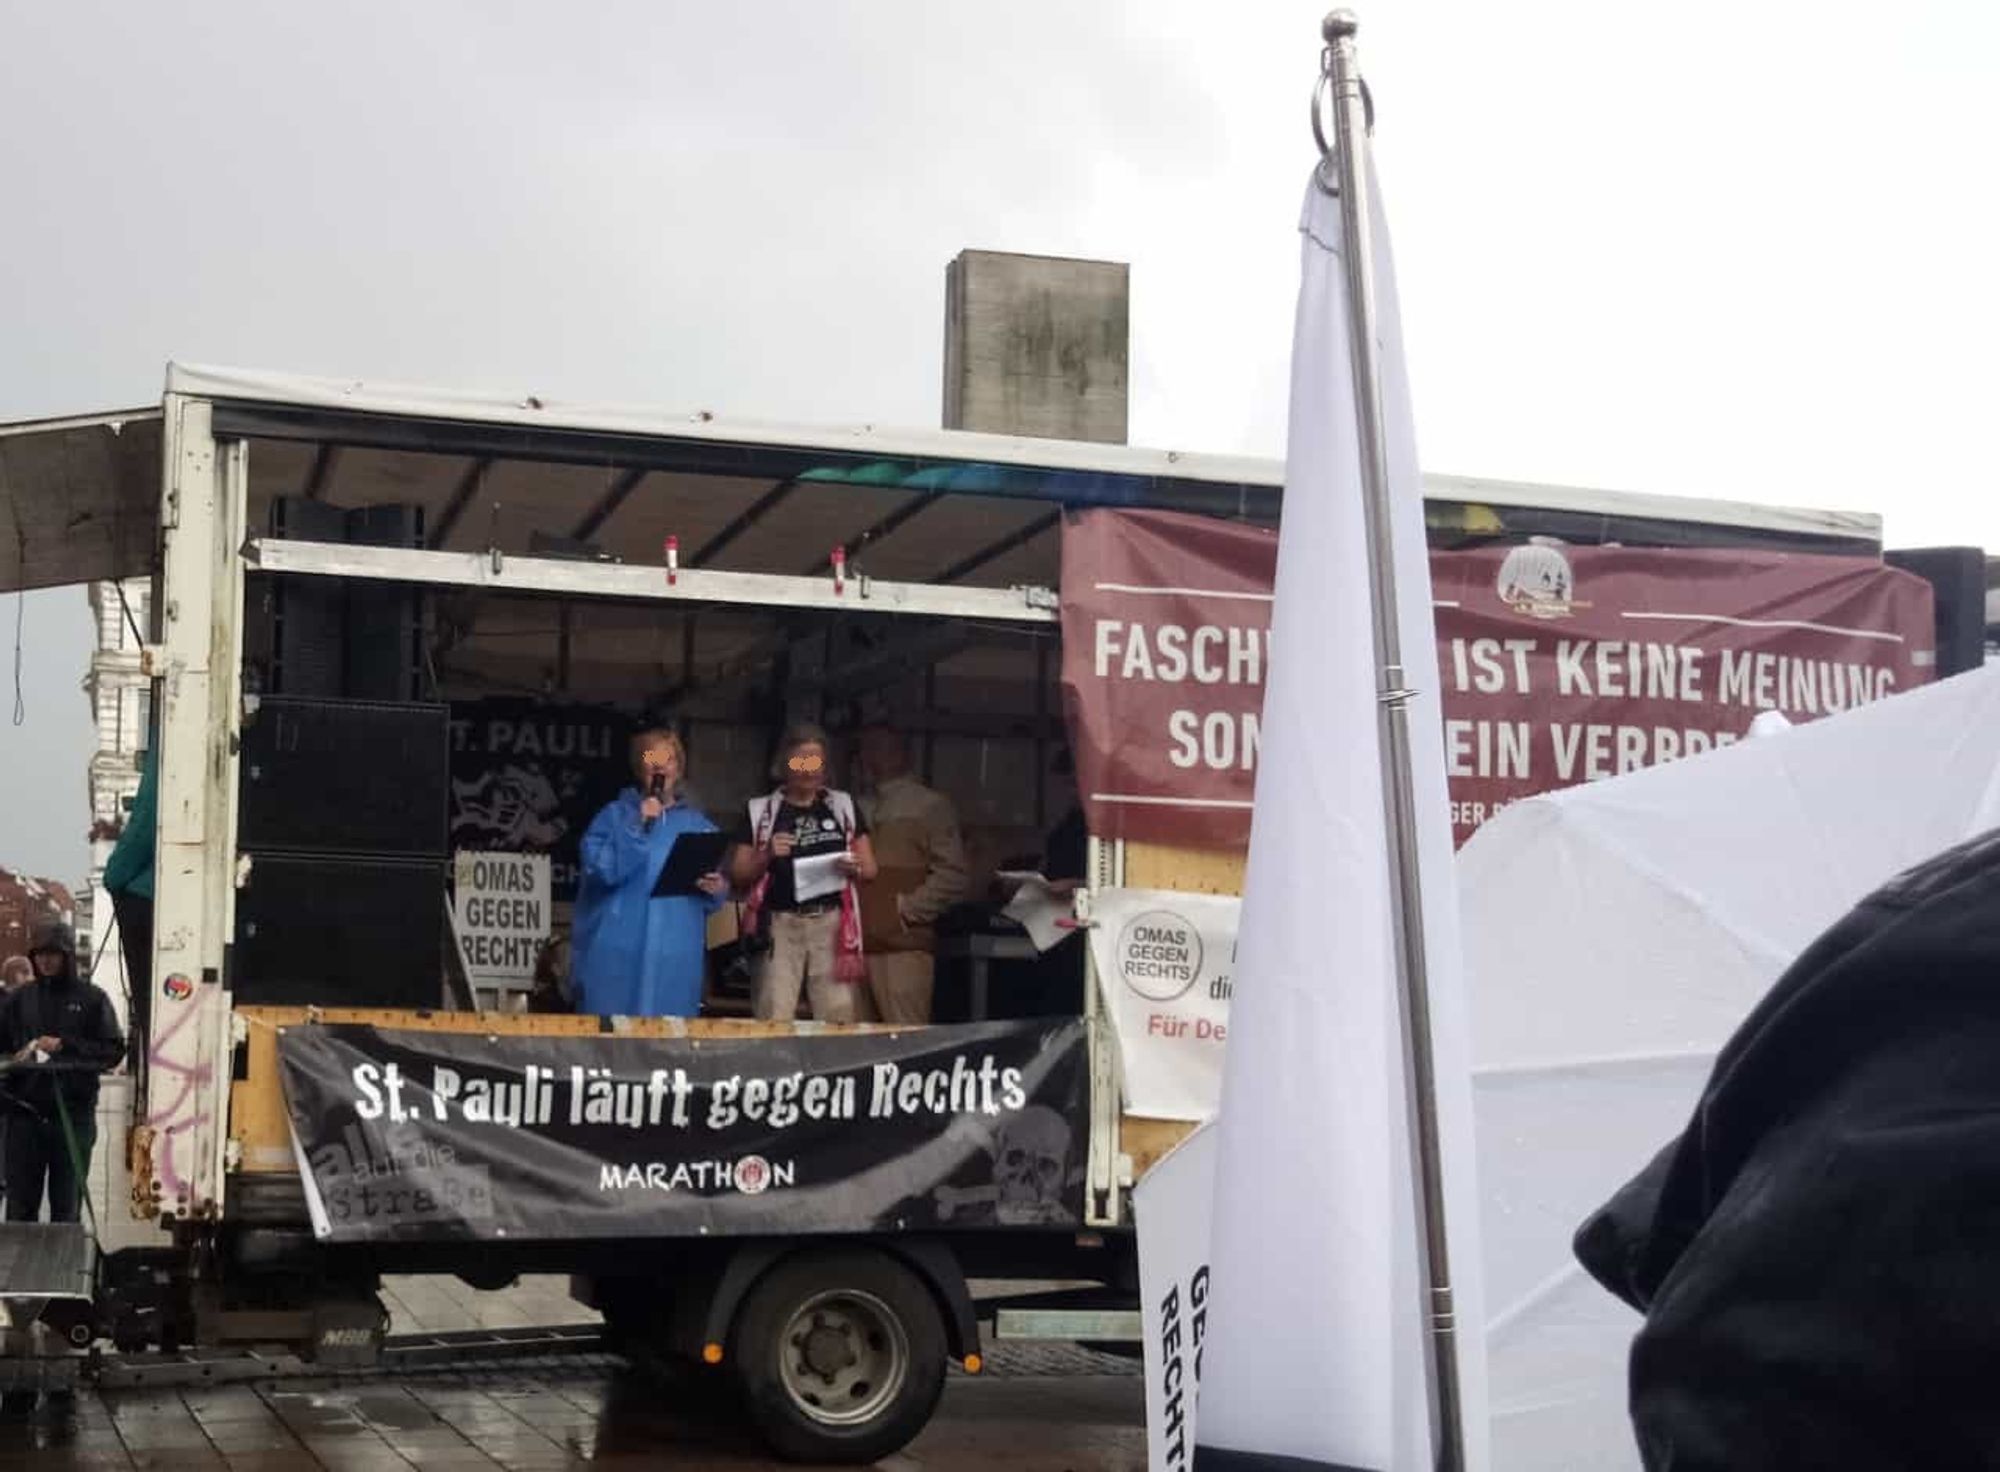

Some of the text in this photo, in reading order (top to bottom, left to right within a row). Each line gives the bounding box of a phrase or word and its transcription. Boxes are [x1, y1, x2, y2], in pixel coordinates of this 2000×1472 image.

[1095, 619, 1272, 684] FASCH
[1452, 637, 1537, 694] IST
[1556, 640, 1704, 701] KEINE
[450, 719, 612, 758] T. PAULI
[1168, 709, 1261, 770] SON
[1447, 720, 1530, 778] EIN
[1450, 801, 1485, 825] GER
[473, 860, 535, 892] OMAS
[466, 897, 541, 930] GEGEN
[1133, 926, 1187, 945] OMAS
[1128, 944, 1189, 963] GEGEN
[1124, 961, 1191, 981] RECHTS
[1147, 1014, 1227, 1041] Für De
[351, 1054, 1026, 1129] St. Pauli läuft gegen Rechts
[1161, 1284, 1186, 1472] RECHT
